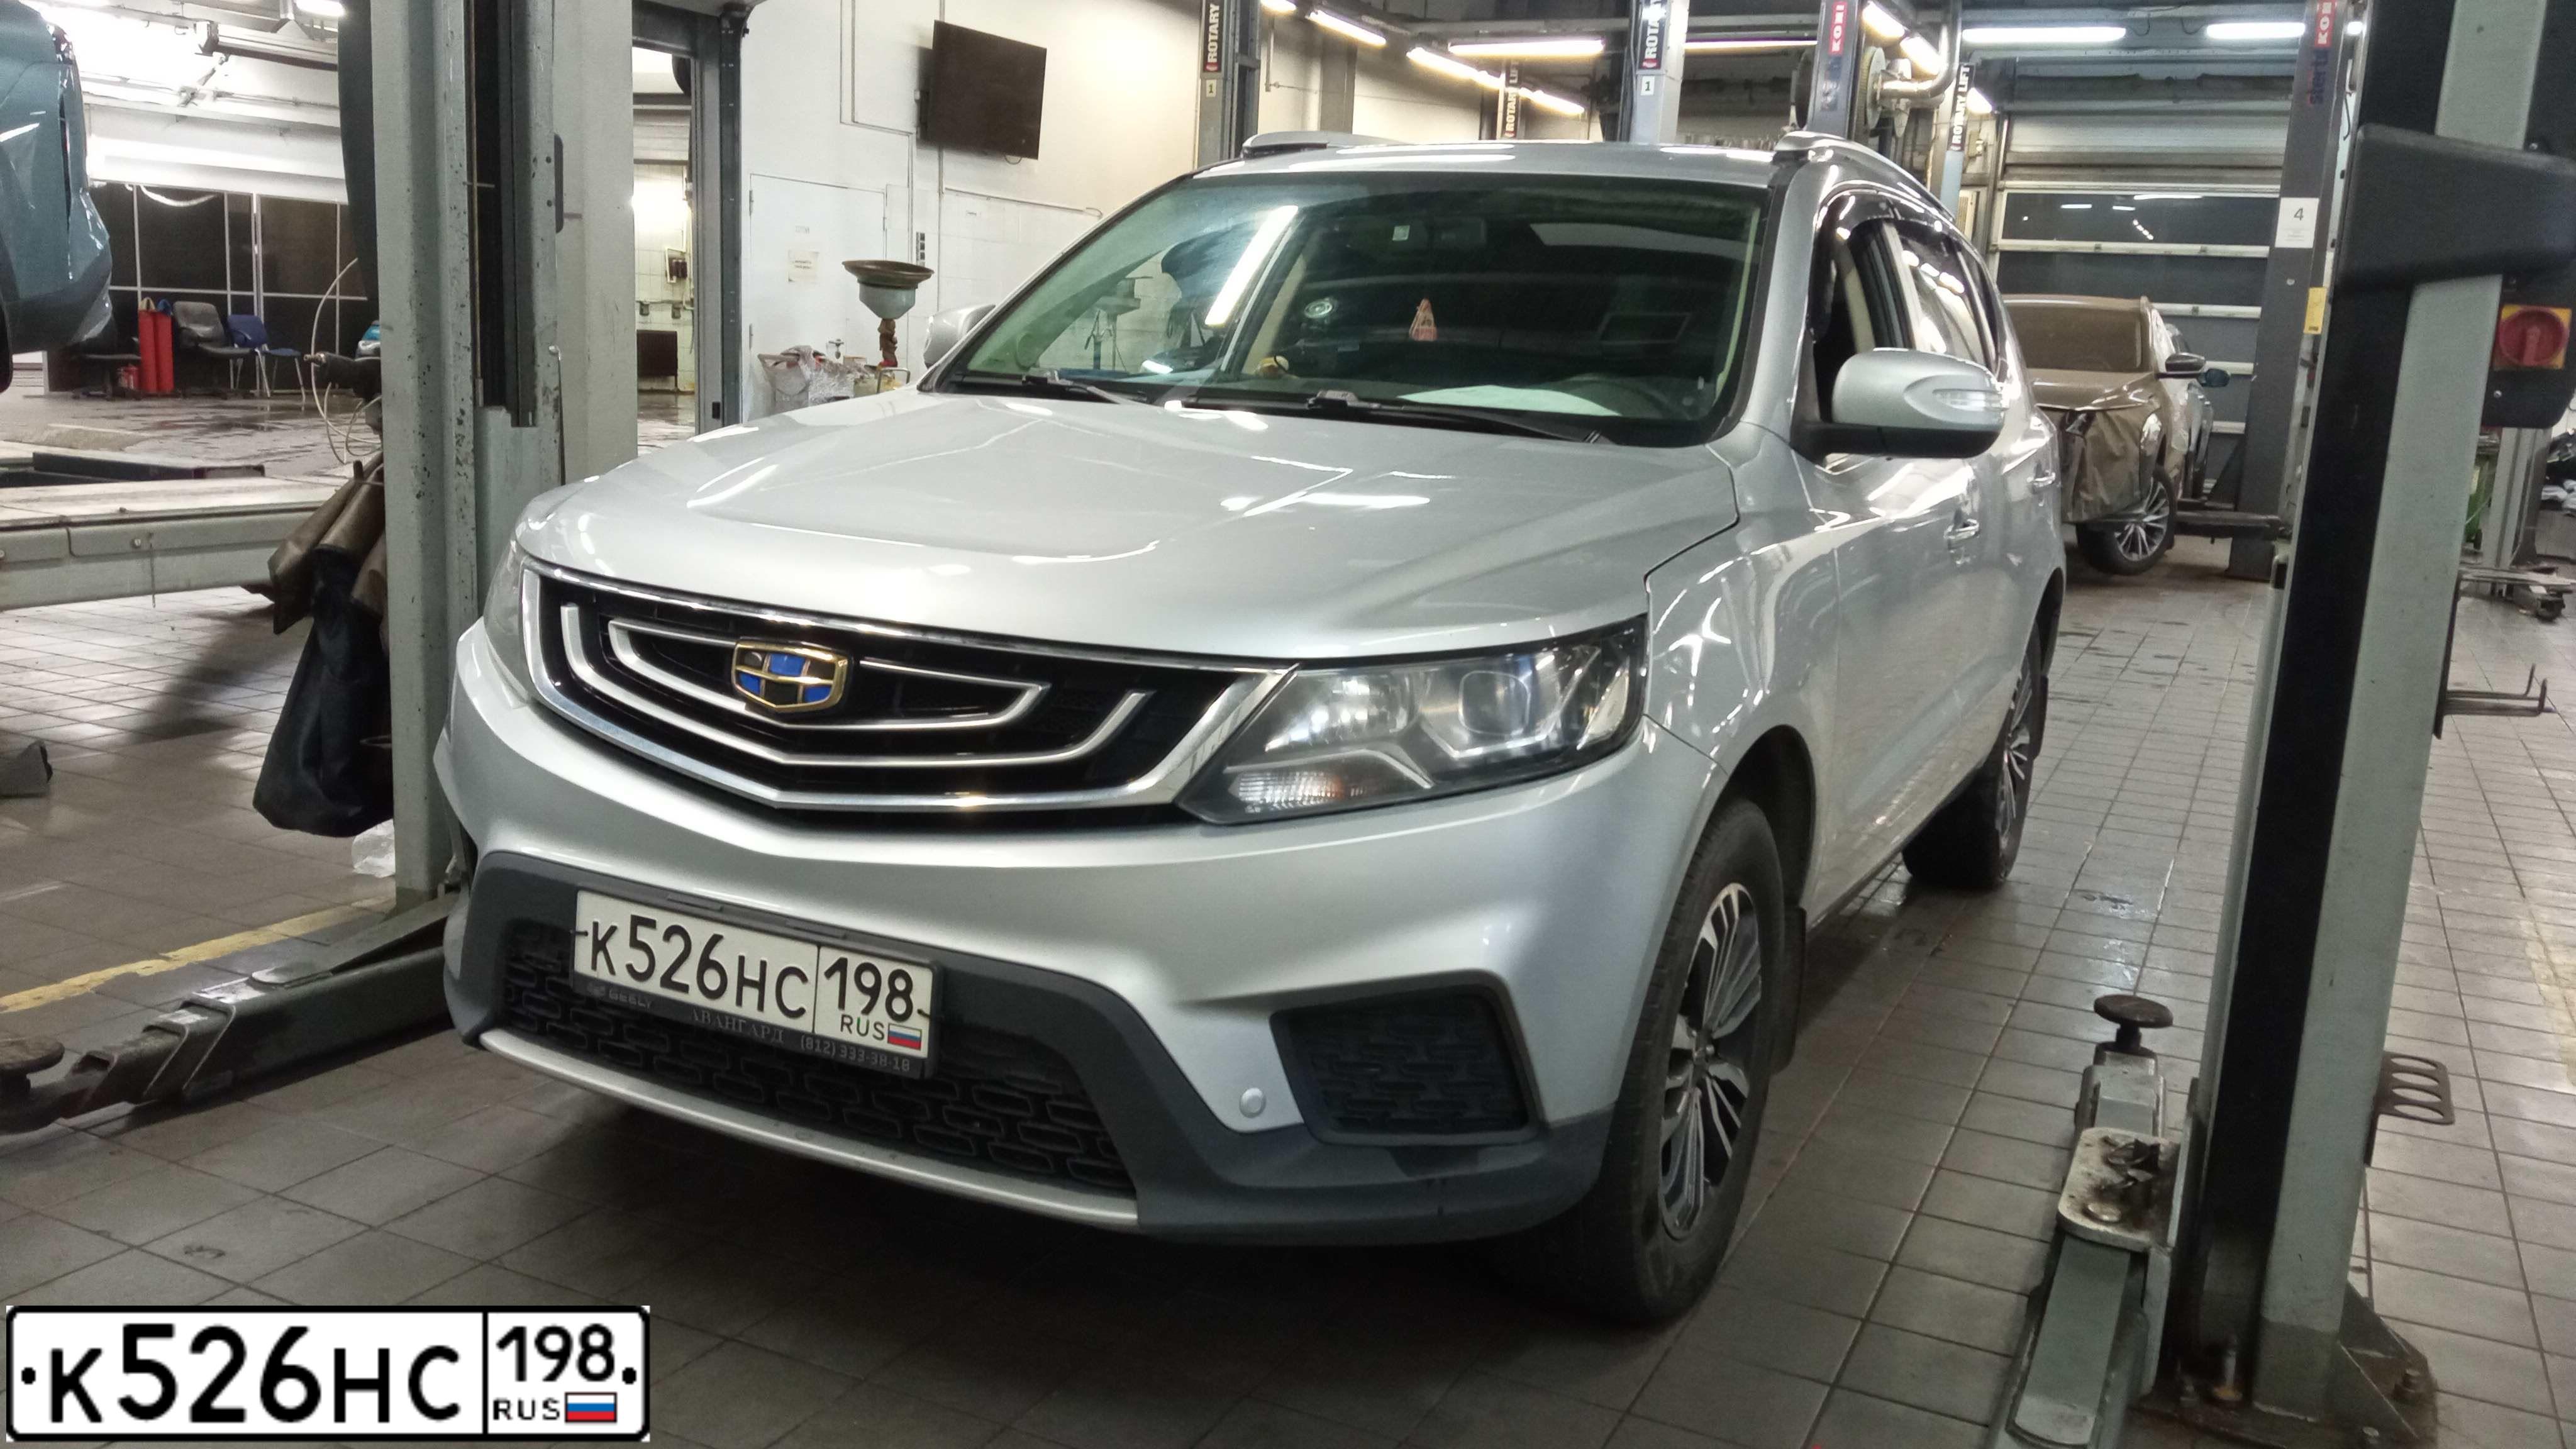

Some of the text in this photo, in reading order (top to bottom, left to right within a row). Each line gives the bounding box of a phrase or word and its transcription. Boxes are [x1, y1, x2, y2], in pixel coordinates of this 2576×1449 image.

[1207, 3, 1219, 62] ROTARY
[1645, 0, 1661, 58] ROTA
[1209, 84, 1214, 94] 1
[1645, 81, 1651, 91] 1
[1958, 65, 1970, 92] LIFT
[1506, 88, 1518, 131] ROTAR
[2294, 208, 2304, 221] 4
[824, 957, 914, 1021] 198
[689, 1007, 784, 1044] АВАНГАРД
[801, 1035, 836, 1058] (812)
[840, 1014, 885, 1041] RUS
